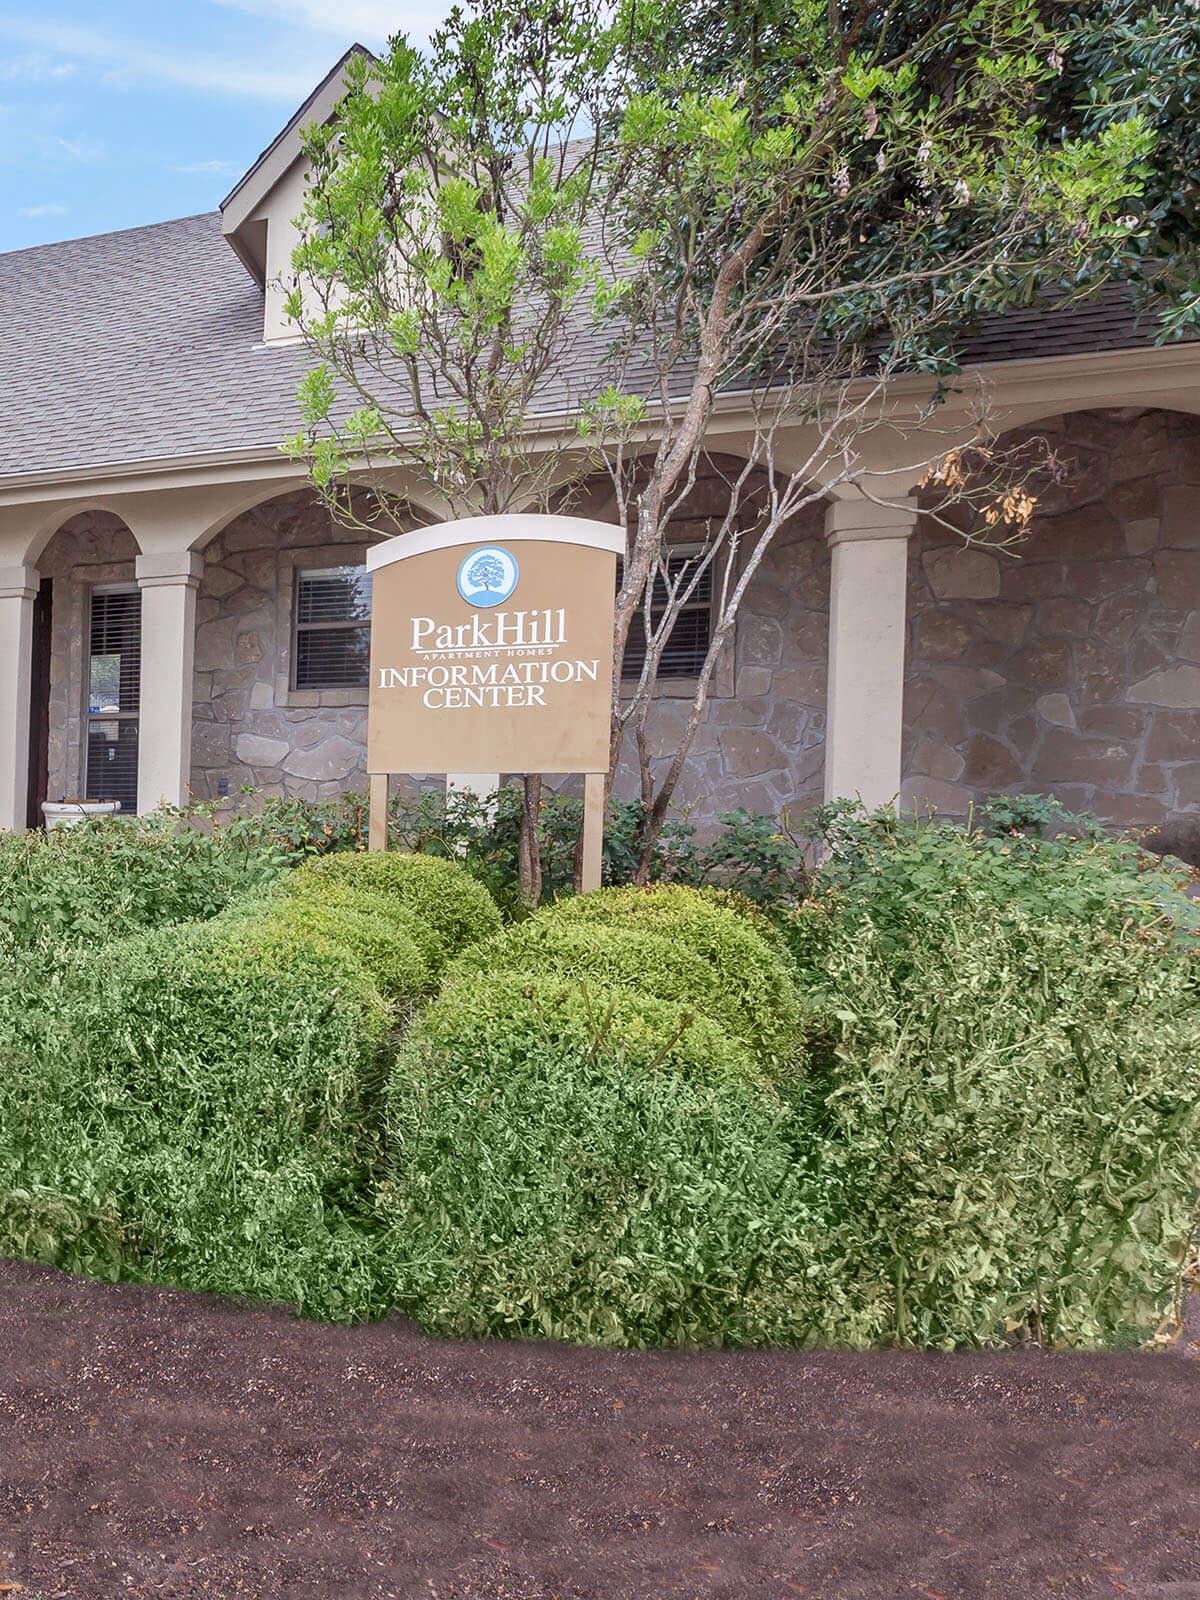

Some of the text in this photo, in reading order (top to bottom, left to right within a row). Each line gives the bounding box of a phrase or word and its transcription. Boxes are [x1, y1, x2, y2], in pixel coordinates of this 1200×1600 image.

[423, 648, 553, 661] APARTMENT HOMES
[377, 660, 600, 688] INFORMATION
[423, 685, 547, 709] CENTER
